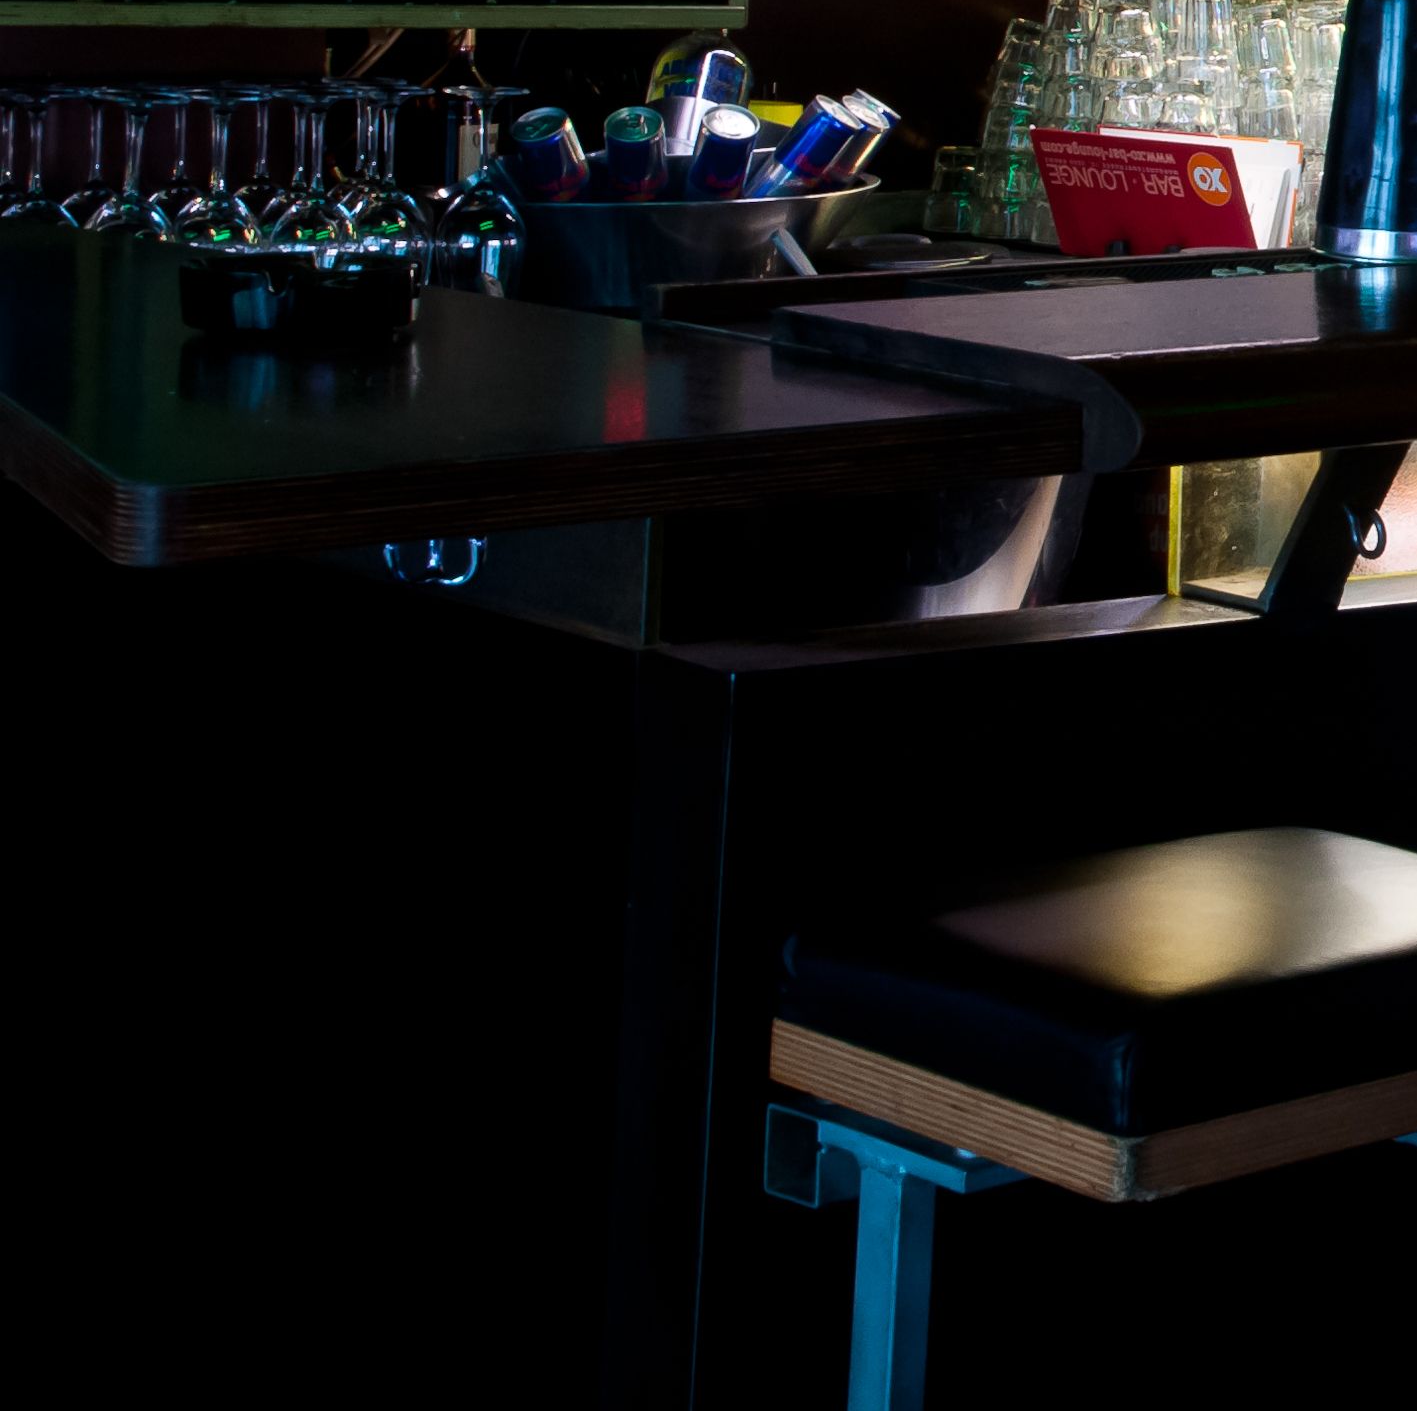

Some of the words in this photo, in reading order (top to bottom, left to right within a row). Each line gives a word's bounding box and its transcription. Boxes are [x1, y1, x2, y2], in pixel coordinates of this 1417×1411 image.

[1040, 141, 1176, 165] www.xo-bar-lounge.com
[1046, 163, 1130, 193] LOUNGE
[1141, 172, 1185, 198] BAR
[1193, 166, 1228, 193] XO
